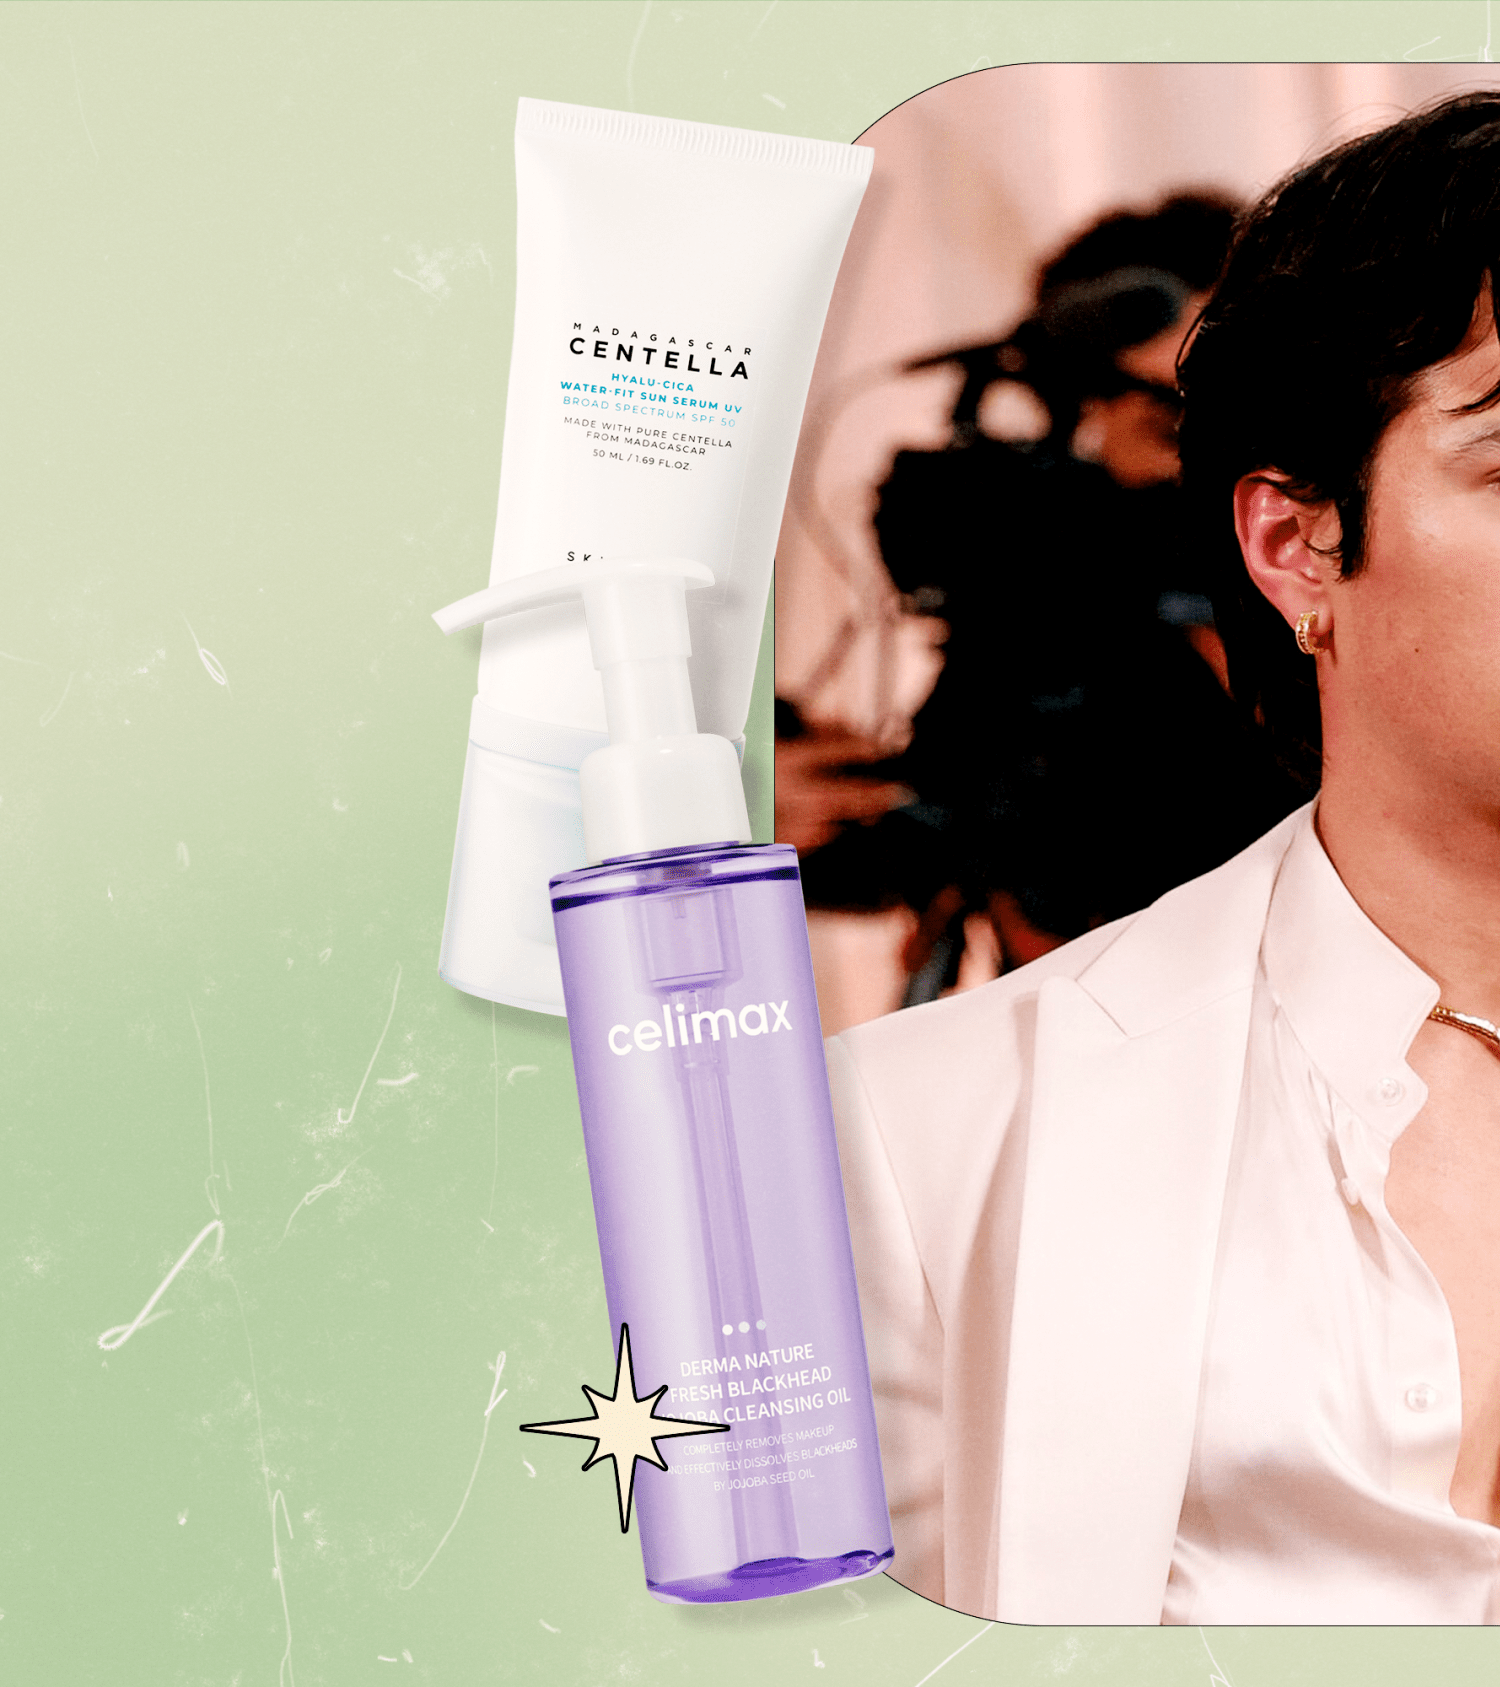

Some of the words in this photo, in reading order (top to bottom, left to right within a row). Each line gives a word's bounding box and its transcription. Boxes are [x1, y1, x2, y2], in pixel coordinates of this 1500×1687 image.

[573, 322, 751, 355] MADAGASCAR
[569, 337, 748, 379] CENTELLA
[561, 381, 634, 398] WATER-FIT
[641, 392, 667, 402] SUN
[673, 396, 718, 410] SERUM
[725, 404, 742, 413] UV
[611, 373, 694, 392] HYALU-CICA
[563, 396, 609, 409] BROAD
[615, 403, 685, 420] SPECTRUM
[692, 413, 715, 424] SPF
[721, 418, 735, 427] 50
[564, 416, 596, 428] MADE
[602, 422, 631, 433] WITH
[637, 427, 667, 439] PURE
[673, 432, 732, 448] CENTELLA
[587, 431, 619, 442] FROM
[625, 437, 706, 455] MADAGASCAR
[593, 449, 605, 457] 50
[610, 451, 624, 461] ML
[635, 455, 655, 465] 1.69
[659, 459, 692, 471] FL.OZ.
[608, 1000, 793, 1056] celimax
[680, 1356, 741, 1377] DERMA
[745, 1343, 814, 1370] NATURE
[670, 1383, 723, 1403] FRESH
[728, 1366, 832, 1397] BLACKHEAD
[724, 1393, 823, 1423] CLEANSING
[827, 1387, 851, 1405] OIL
[684, 1440, 743, 1455] COMPLETELY
[746, 1433, 794, 1449] REMOVES
[796, 1425, 834, 1441] MAKEUP
[684, 1460, 742, 1474] EFFECTIVELY
[744, 1452, 799, 1469] DISSOLVES
[801, 1438, 857, 1459] BLACKHEADS
[714, 1481, 725, 1491] BY
[728, 1476, 768, 1489] JOJOBA
[770, 1471, 796, 1484] SEED
[798, 1469, 814, 1479] OIL
